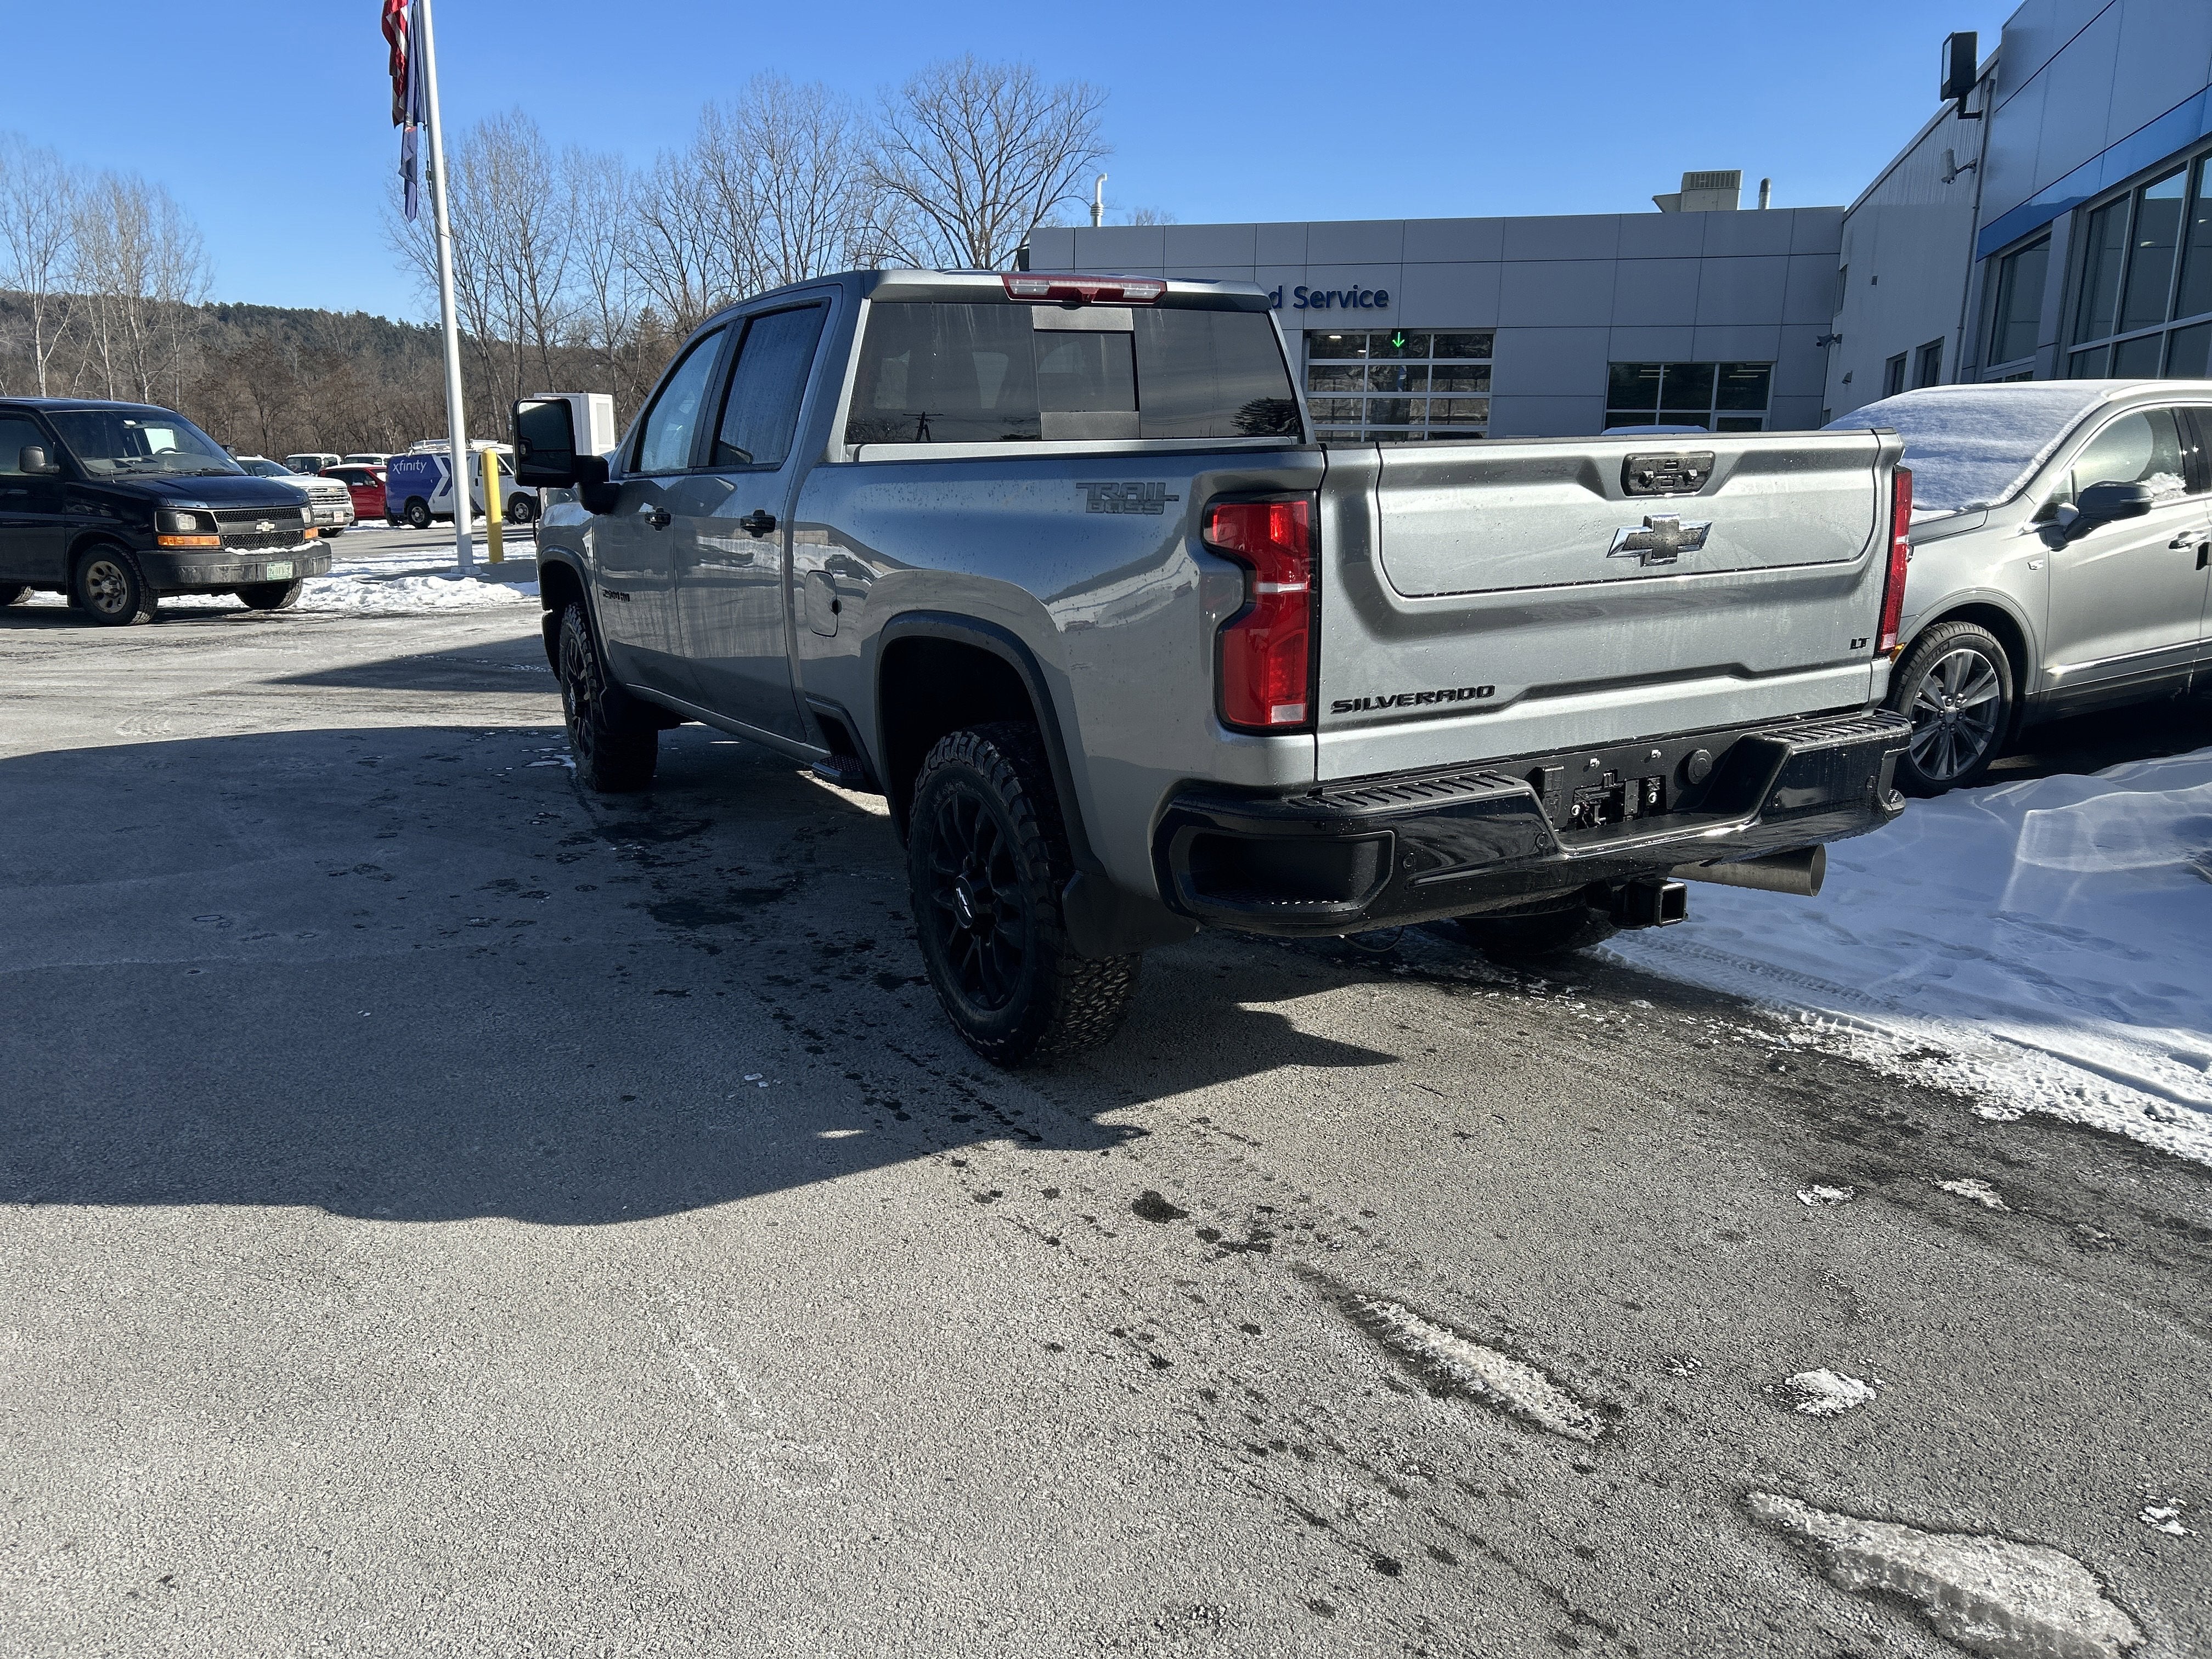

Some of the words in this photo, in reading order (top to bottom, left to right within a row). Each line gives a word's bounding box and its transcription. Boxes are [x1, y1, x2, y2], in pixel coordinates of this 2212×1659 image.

[1293, 284, 1389, 309] Service
[392, 459, 427, 475] xfinity
[1076, 482, 1179, 502] TRAIL
[1086, 500, 1164, 515] BOSS
[1849, 637, 1870, 650] LT
[1916, 642, 1949, 680] MICHELIN
[1330, 685, 1496, 714] SILVERADO
